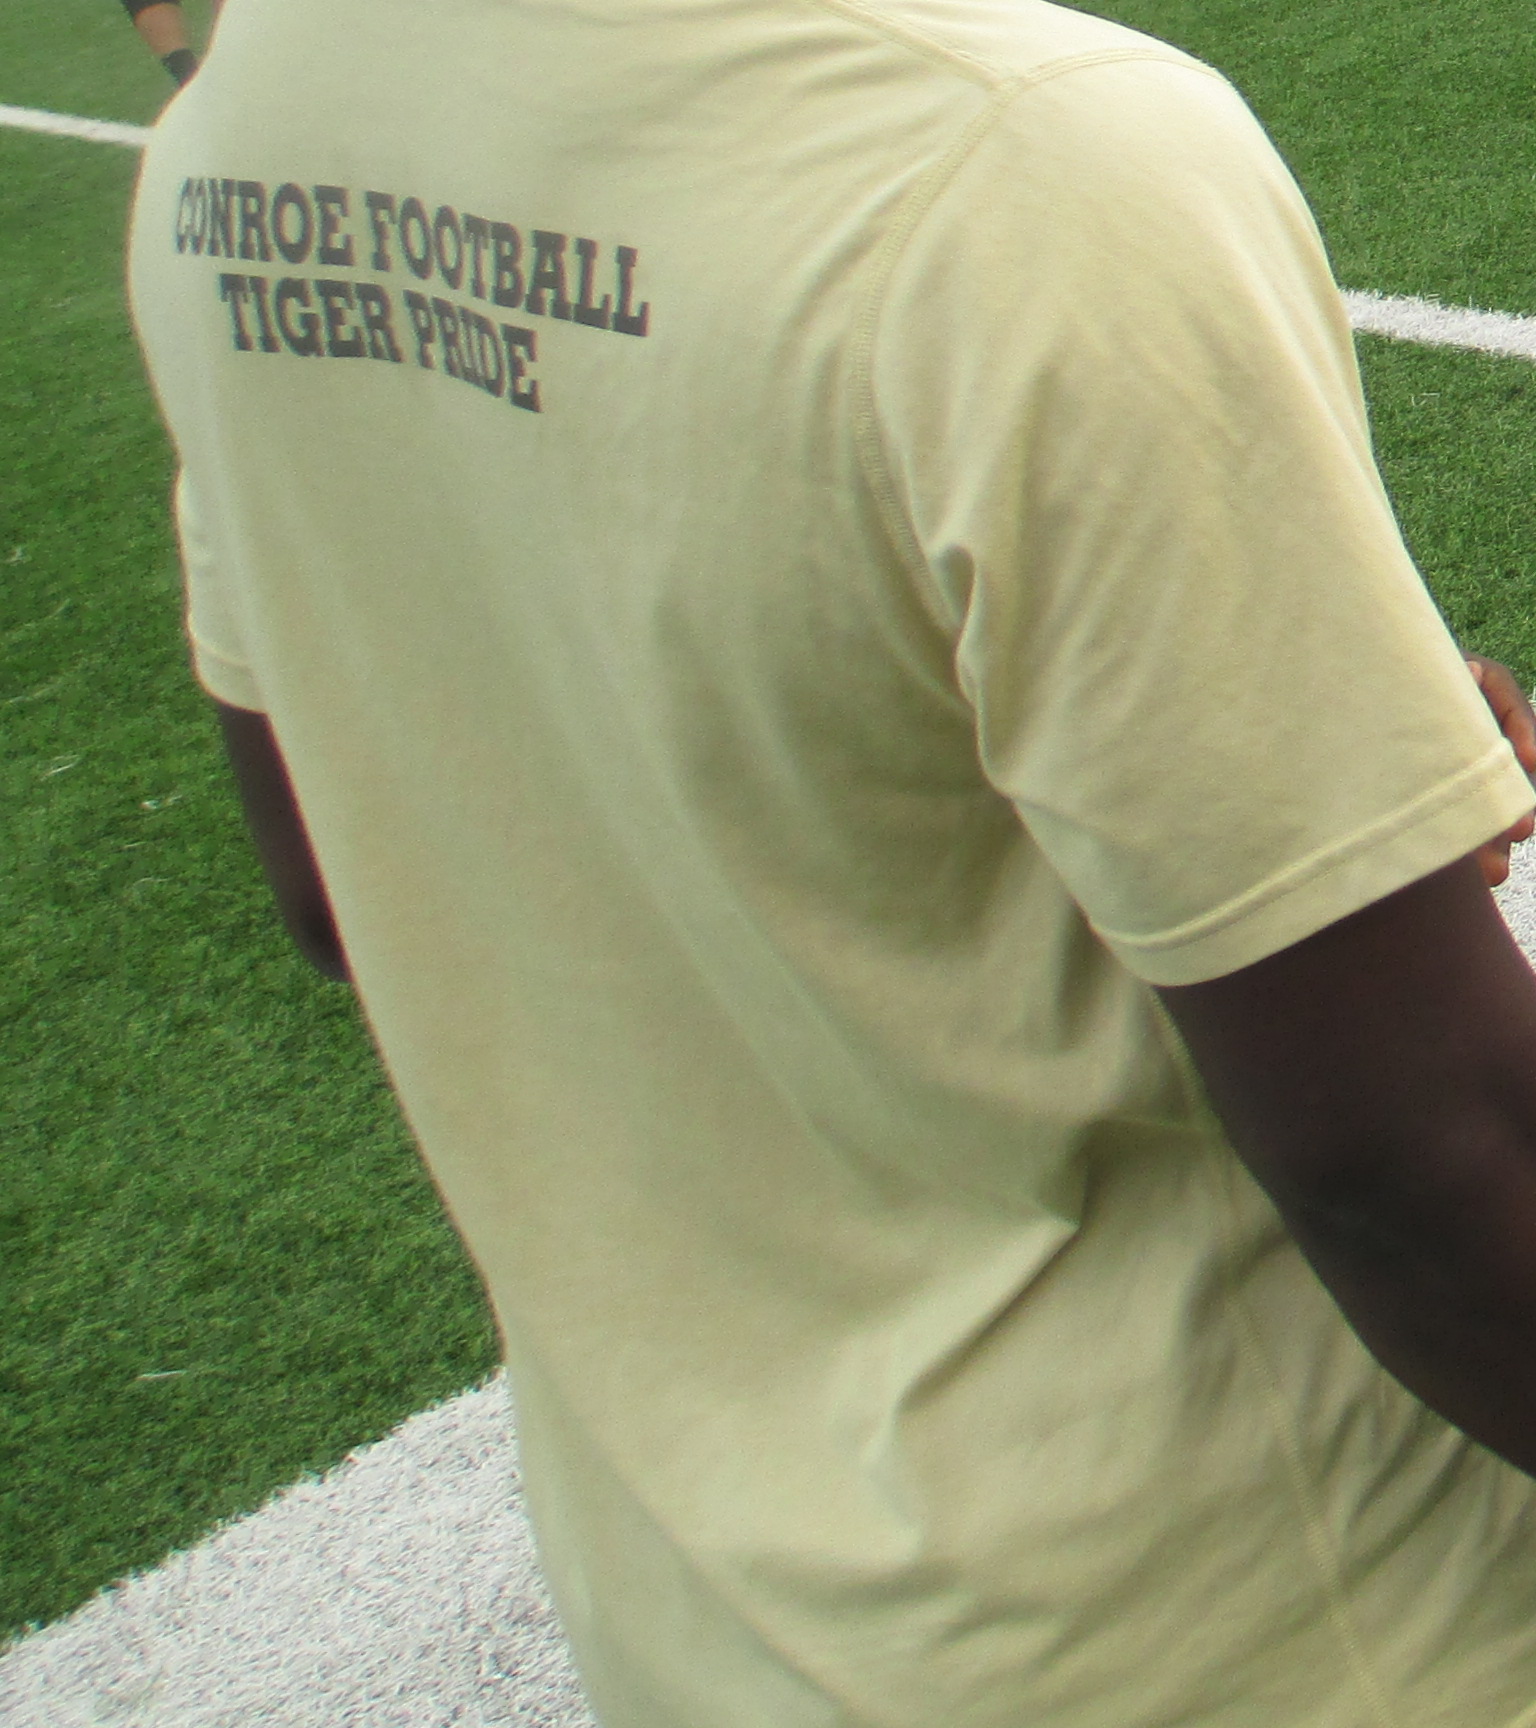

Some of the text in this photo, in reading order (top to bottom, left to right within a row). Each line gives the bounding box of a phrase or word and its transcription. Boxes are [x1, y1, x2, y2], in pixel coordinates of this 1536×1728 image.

[175, 176, 651, 338] CONROE FOOTBALL
[218, 272, 543, 415] TIGER PRIDE
